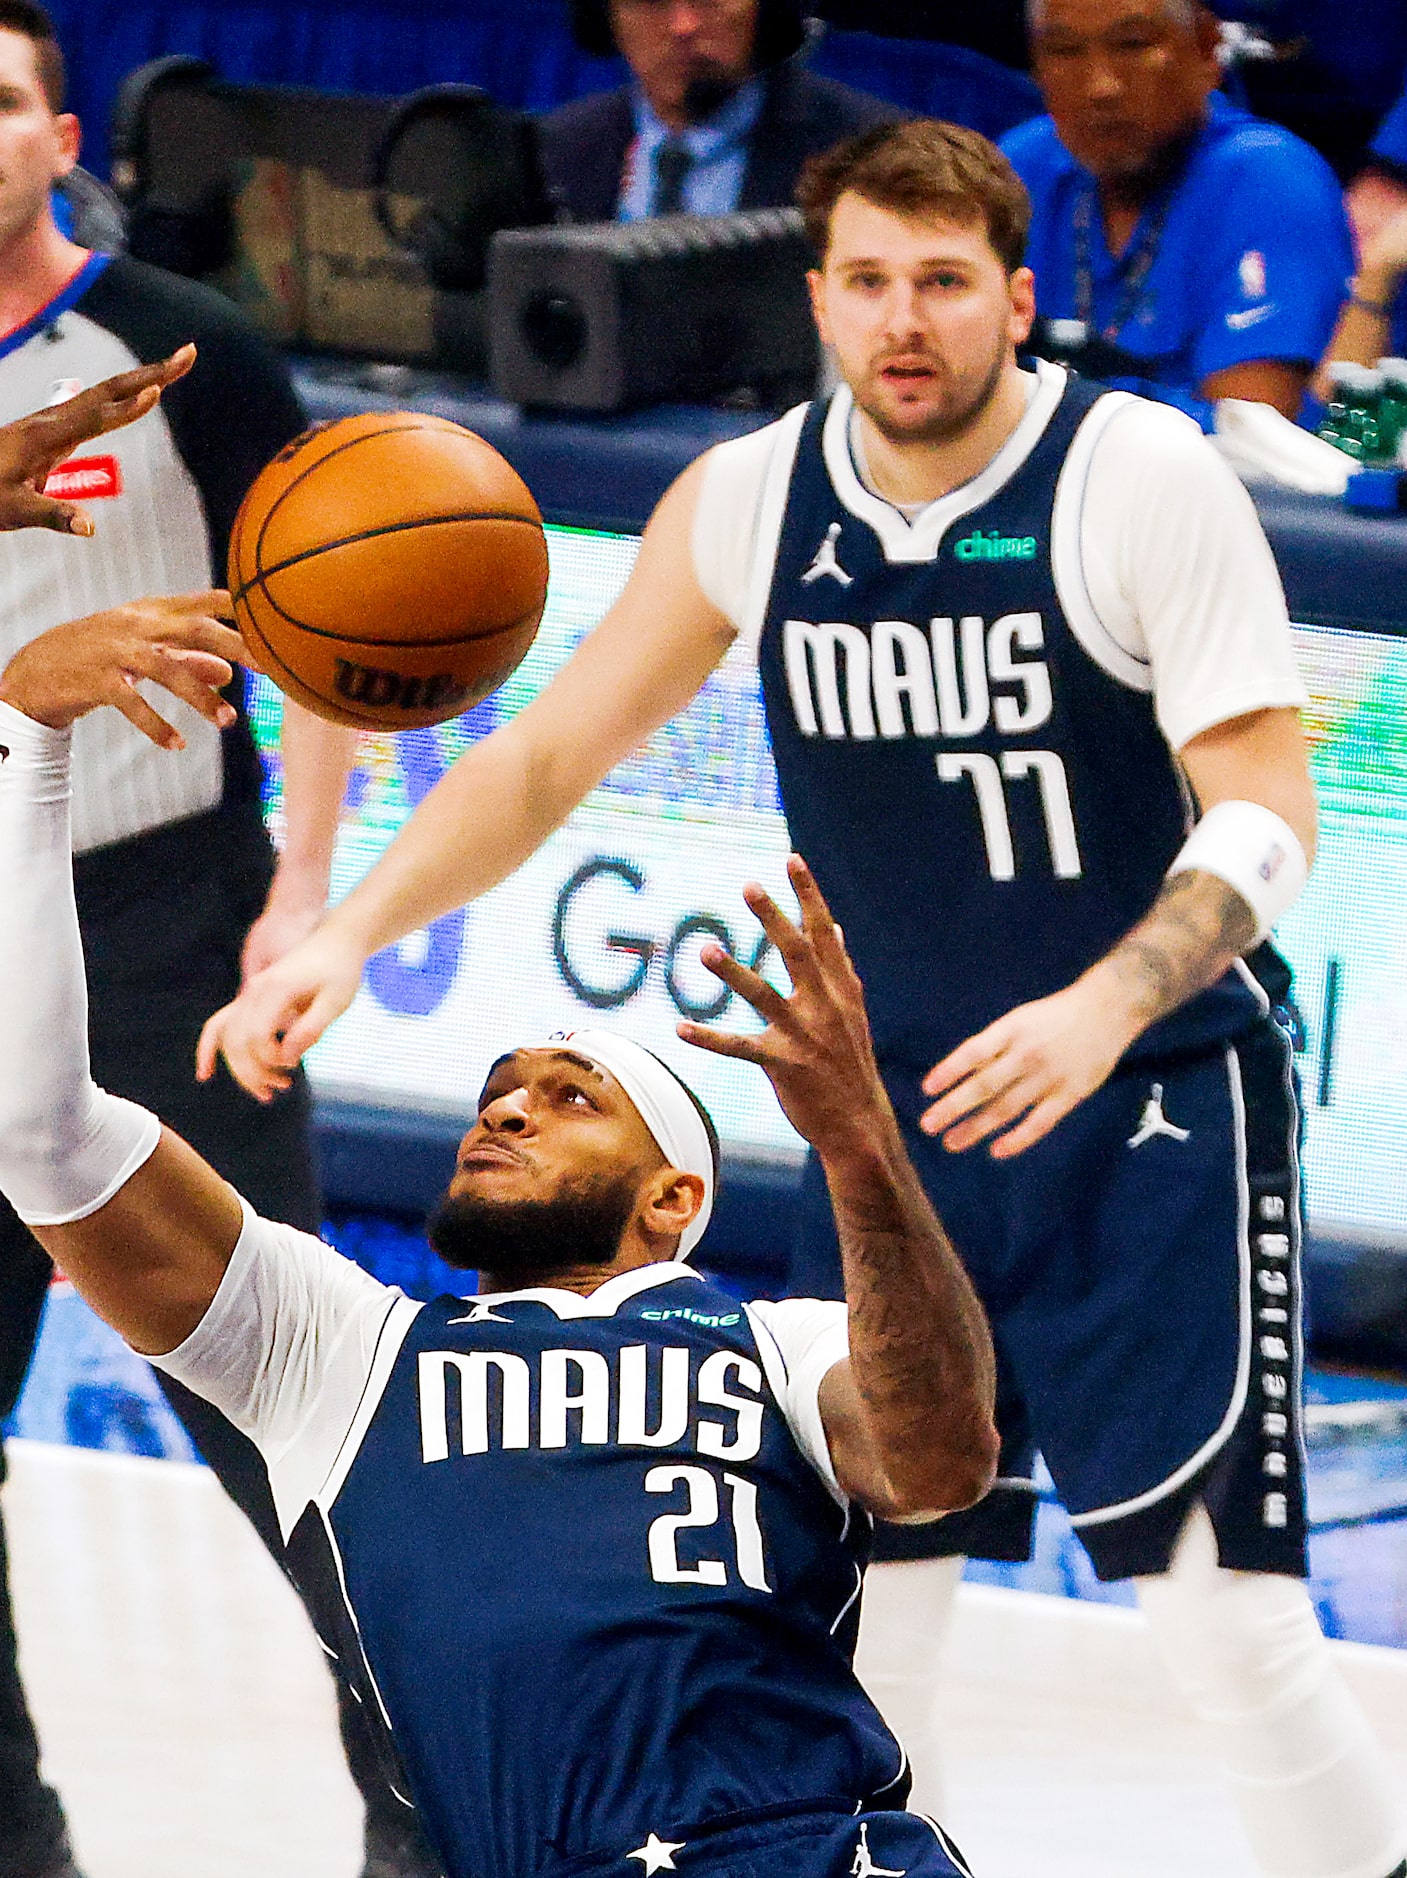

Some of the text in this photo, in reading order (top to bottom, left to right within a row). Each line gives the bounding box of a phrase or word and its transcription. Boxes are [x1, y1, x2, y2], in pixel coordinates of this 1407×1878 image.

[954, 529, 1037, 561] chime
[783, 612, 1053, 740] MAVS
[937, 750, 1083, 881] 77
[418, 1344, 765, 1464] MAVS
[644, 1464, 772, 1594] 21
